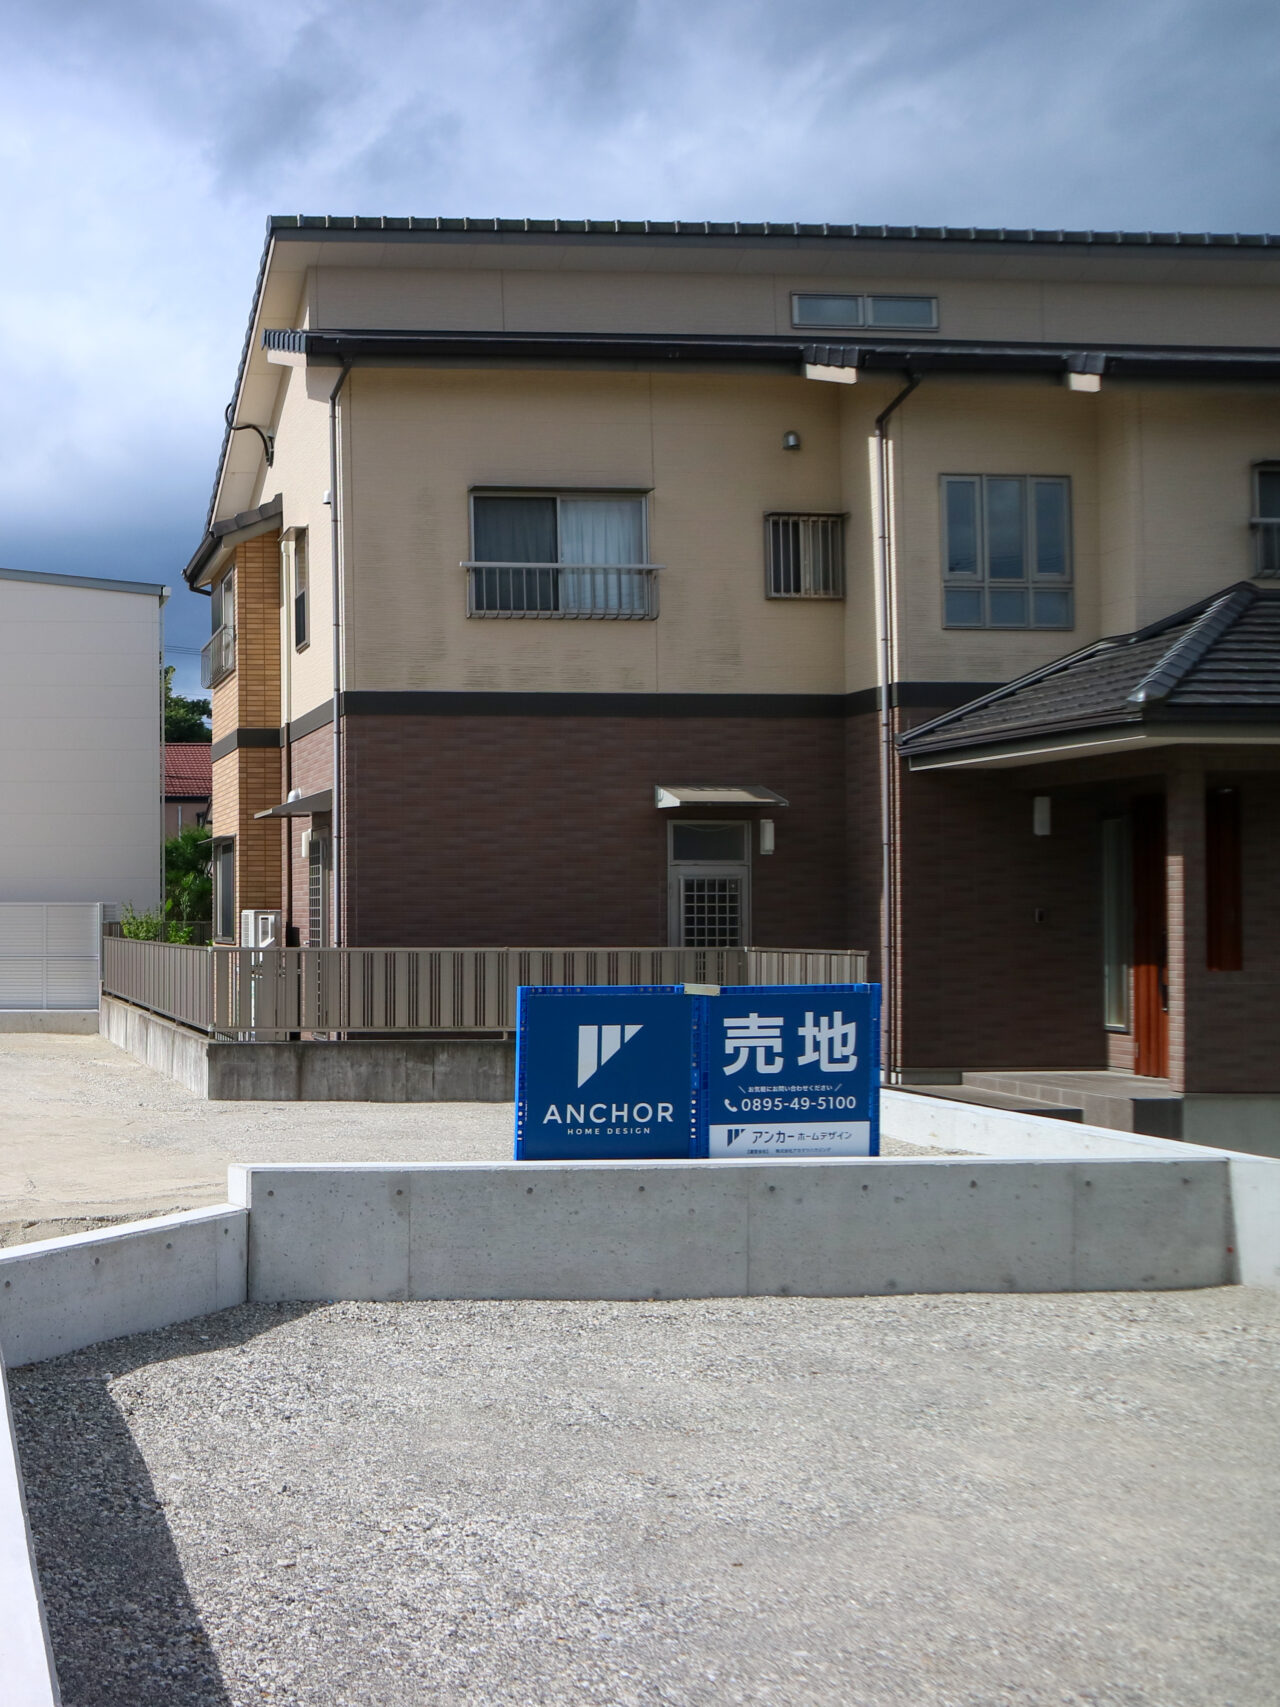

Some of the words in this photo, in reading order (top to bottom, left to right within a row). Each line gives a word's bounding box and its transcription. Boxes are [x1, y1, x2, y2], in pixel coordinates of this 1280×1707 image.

[722, 1010, 858, 1076] 売地
[741, 1096, 856, 1111] 0895-49-5100
[542, 1102, 674, 1124] ANCHOR
[607, 1127, 651, 1135] DESIGN
